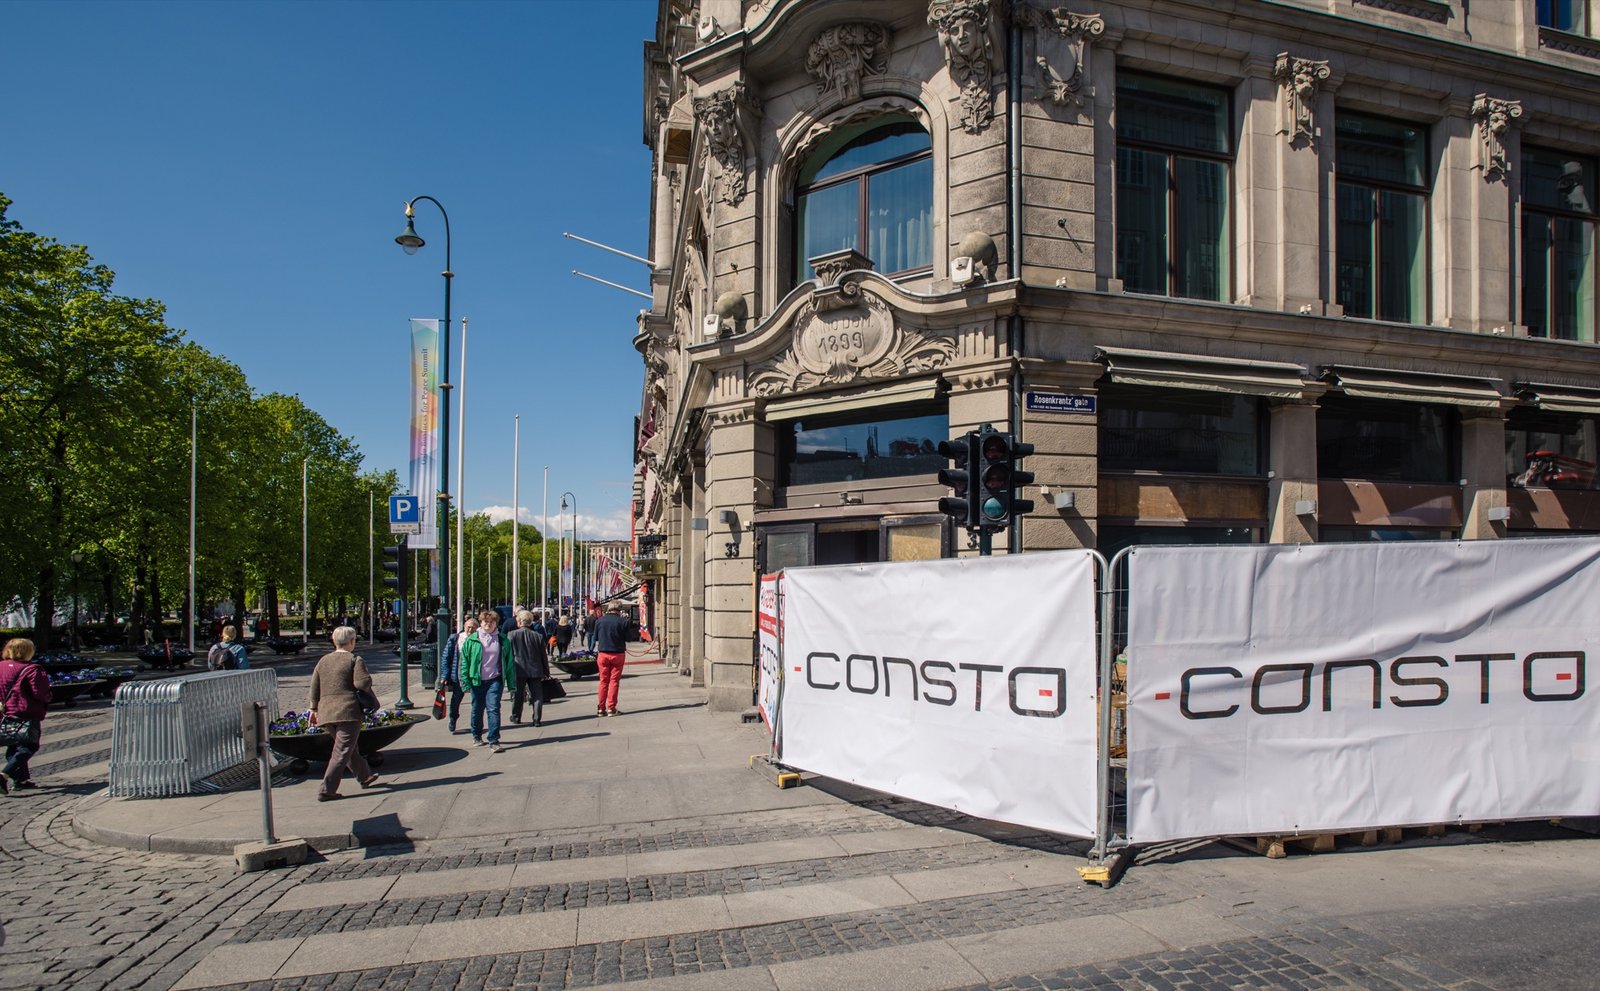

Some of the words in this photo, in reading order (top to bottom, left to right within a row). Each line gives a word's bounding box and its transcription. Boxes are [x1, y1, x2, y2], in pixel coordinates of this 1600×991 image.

[818, 331, 863, 354] 1899
[420, 401, 428, 413] for
[1074, 397, 1089, 408] gate
[396, 499, 411, 520] P
[806, 651, 1067, 719] CONSTO
[1179, 650, 1586, 720] CONSTO
